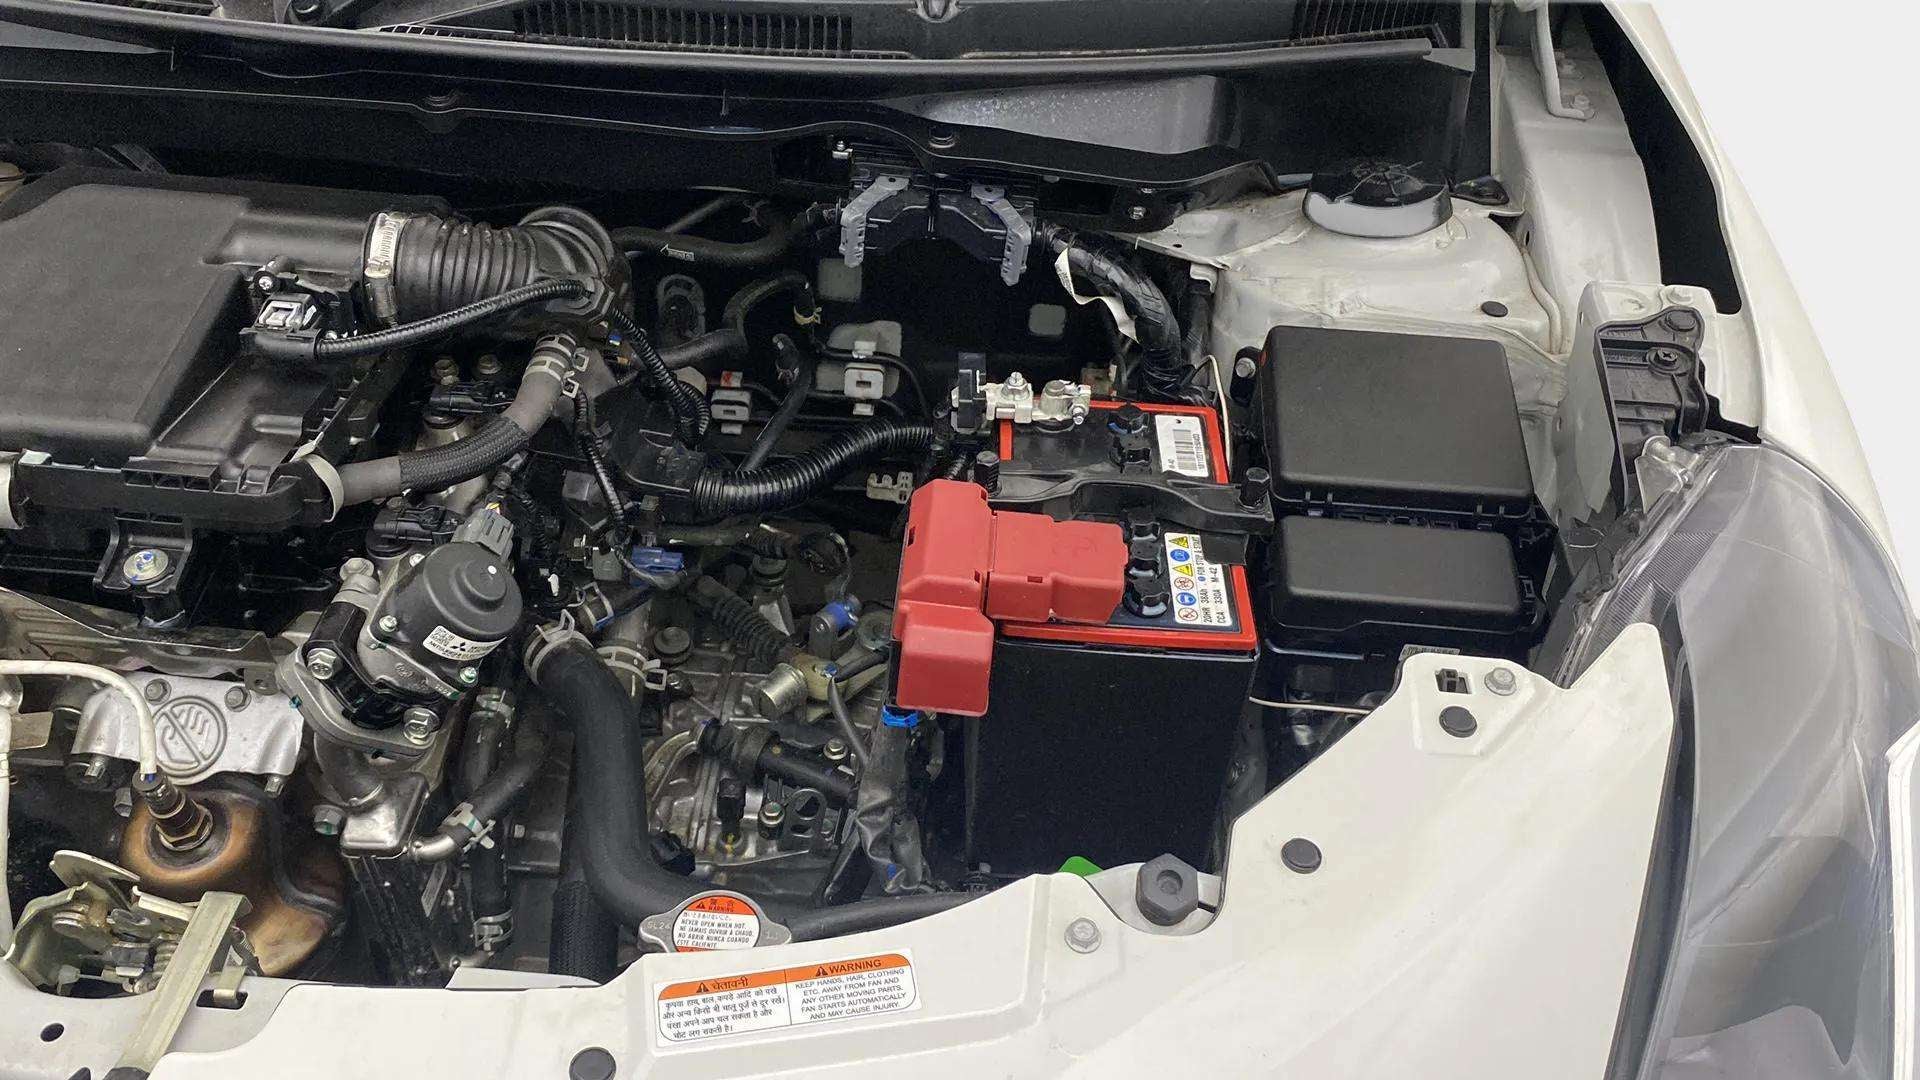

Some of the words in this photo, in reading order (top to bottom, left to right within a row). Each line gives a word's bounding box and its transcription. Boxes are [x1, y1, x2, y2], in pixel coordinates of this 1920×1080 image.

[1209, 567, 1219, 582] M-42
[1201, 607, 1212, 623] 20HR
[1216, 611, 1226, 623] CCA
[689, 926, 707, 934] JAMAIS
[829, 959, 882, 974] WARNING
[713, 976, 749, 990] चेतावनी
[796, 981, 815, 989] KEEP
[817, 977, 843, 986] HANDS,
[846, 973, 866, 982] HAIR,
[868, 968, 905, 979] CLOTHING
[737, 990, 752, 999] आदि
[755, 988, 763, 996] को
[803, 989, 820, 997] ETC.
[822, 985, 842, 994] AWAY
[844, 982, 866, 990] FROM
[884, 977, 900, 985] AND
[801, 998, 816, 1006] ANY
[818, 993, 844, 1003] OTHER
[846, 988, 876, 998] MOVING
[818, 1001, 846, 1011] STARTS
[848, 992, 907, 1007] AUTOMATICALLY
[663, 1011, 675, 1020] और
[677, 1009, 692, 1018] अन्य
[694, 1005, 711, 1015] किसी
[751, 999, 758, 1007] से
[760, 999, 769, 1009] दूर
[810, 1012, 826, 1020] AND
[828, 1009, 844, 1018] MAY
[845, 1006, 871, 1015] CAUSE
[683, 1016, 700, 1027] अपने
[702, 1017, 715, 1025] आप
[731, 1012, 751, 1020] सकता
[753, 1009, 758, 1018] है
[760, 1008, 773, 1016] और
[672, 1030, 686, 1039] चोट
[702, 1024, 722, 1035] सकती
